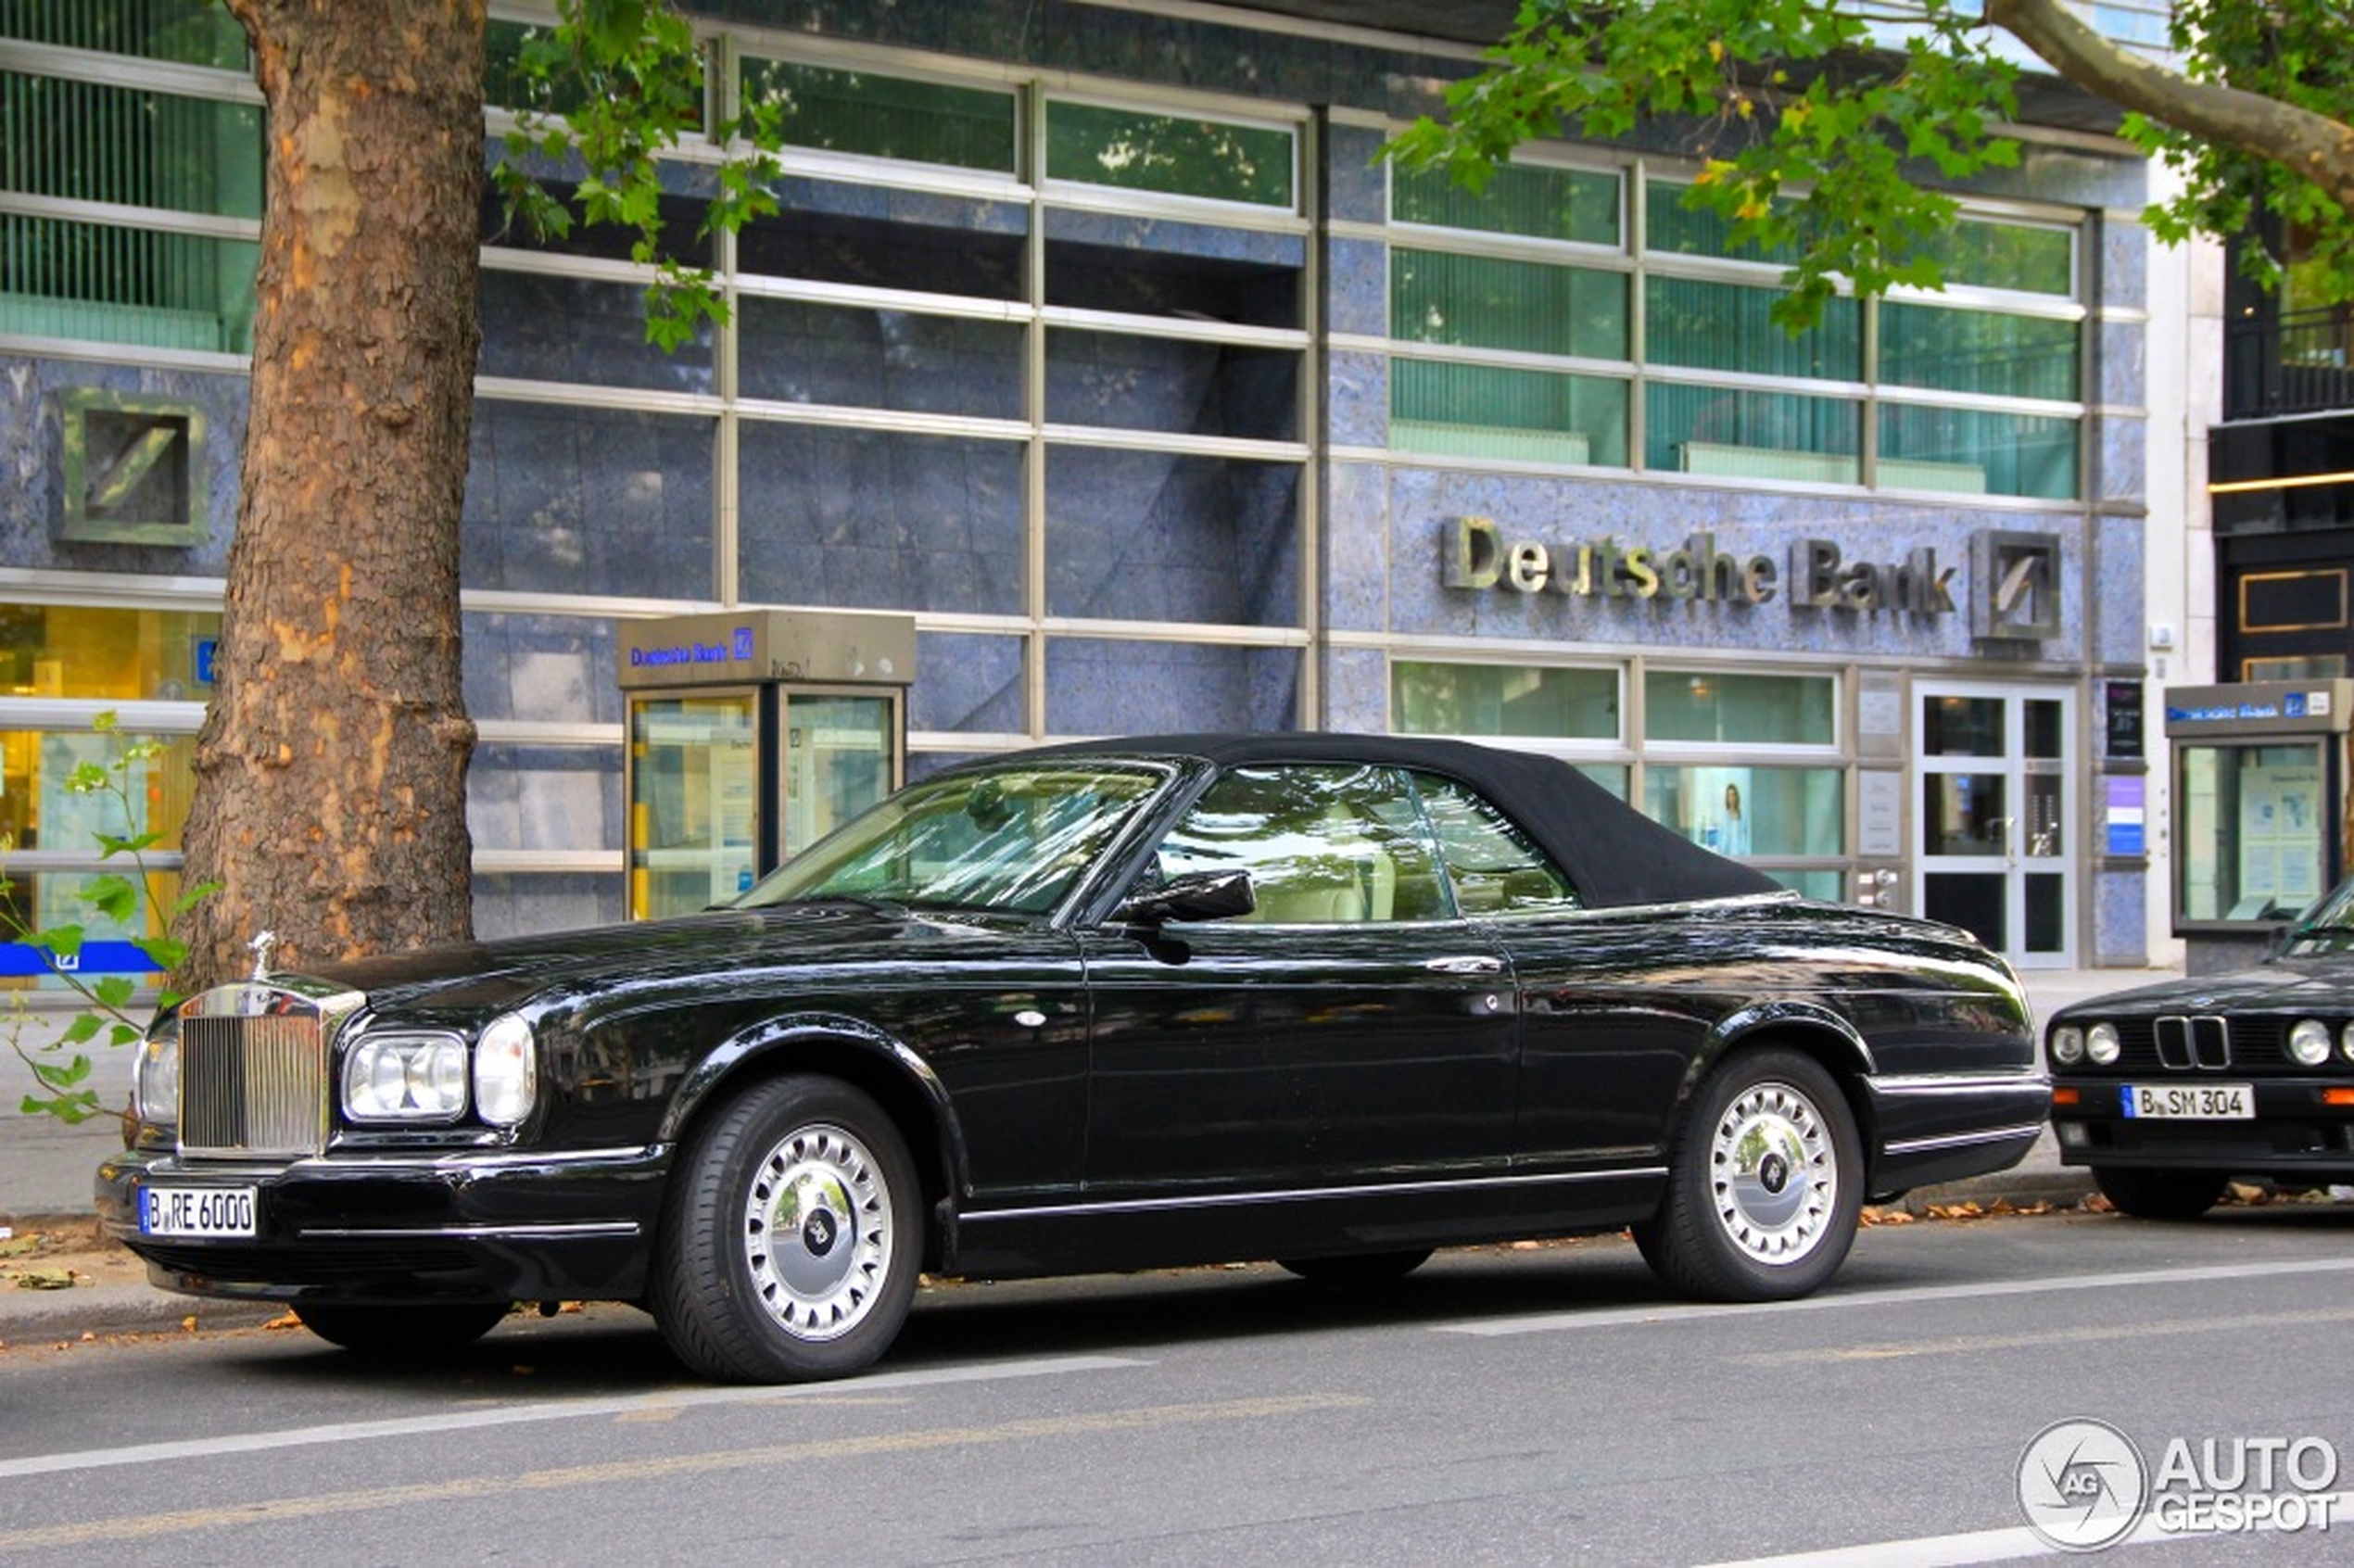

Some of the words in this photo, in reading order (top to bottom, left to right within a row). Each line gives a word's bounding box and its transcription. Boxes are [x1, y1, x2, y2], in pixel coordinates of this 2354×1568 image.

[1443, 515, 1778, 604] Deutsche
[1789, 538, 1956, 613] Bank
[2141, 1090, 2154, 1114] B
[2169, 1090, 2196, 1115] SM
[2201, 1090, 2243, 1115] 304
[149, 1193, 160, 1228] B
[171, 1193, 196, 1230] RE
[199, 1193, 252, 1231] 6000
